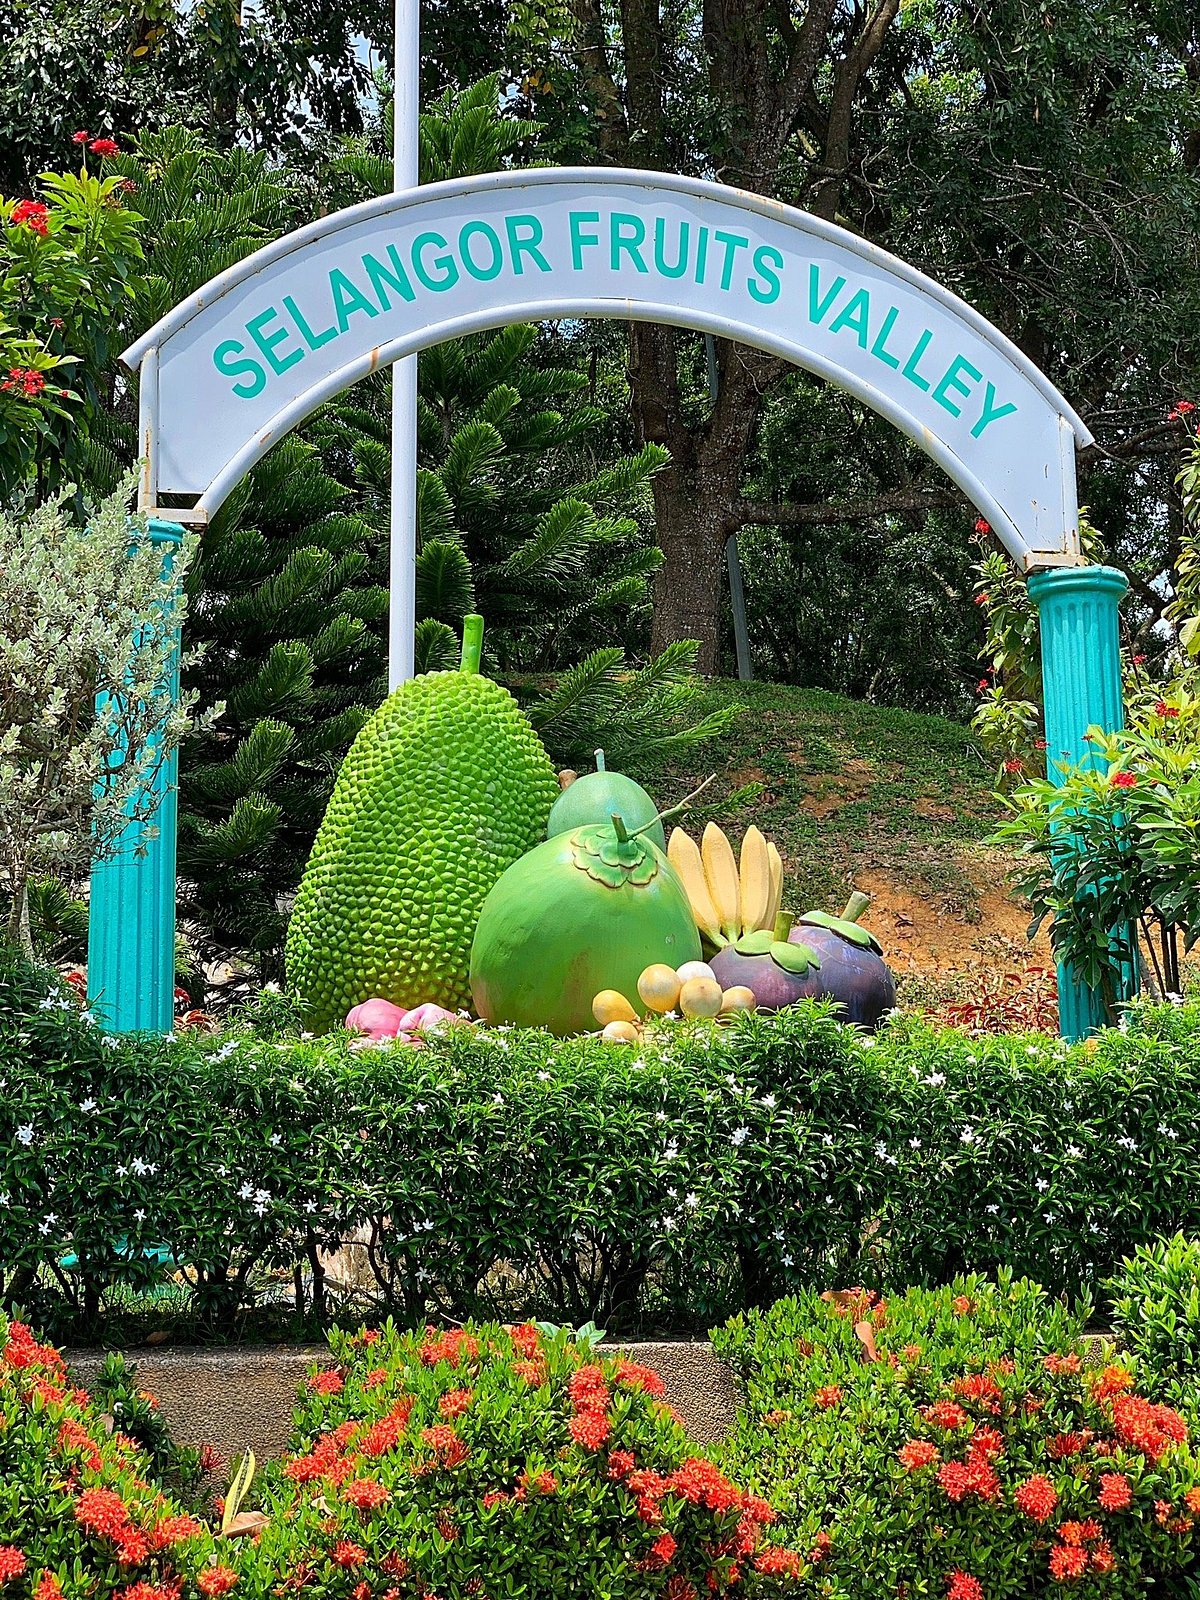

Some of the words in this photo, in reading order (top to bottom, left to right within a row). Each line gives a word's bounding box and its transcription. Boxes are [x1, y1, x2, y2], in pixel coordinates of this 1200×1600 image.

[213, 214, 552, 399] SELANGOR
[569, 211, 785, 305] FRUITS
[809, 264, 1018, 440] VALLEY
